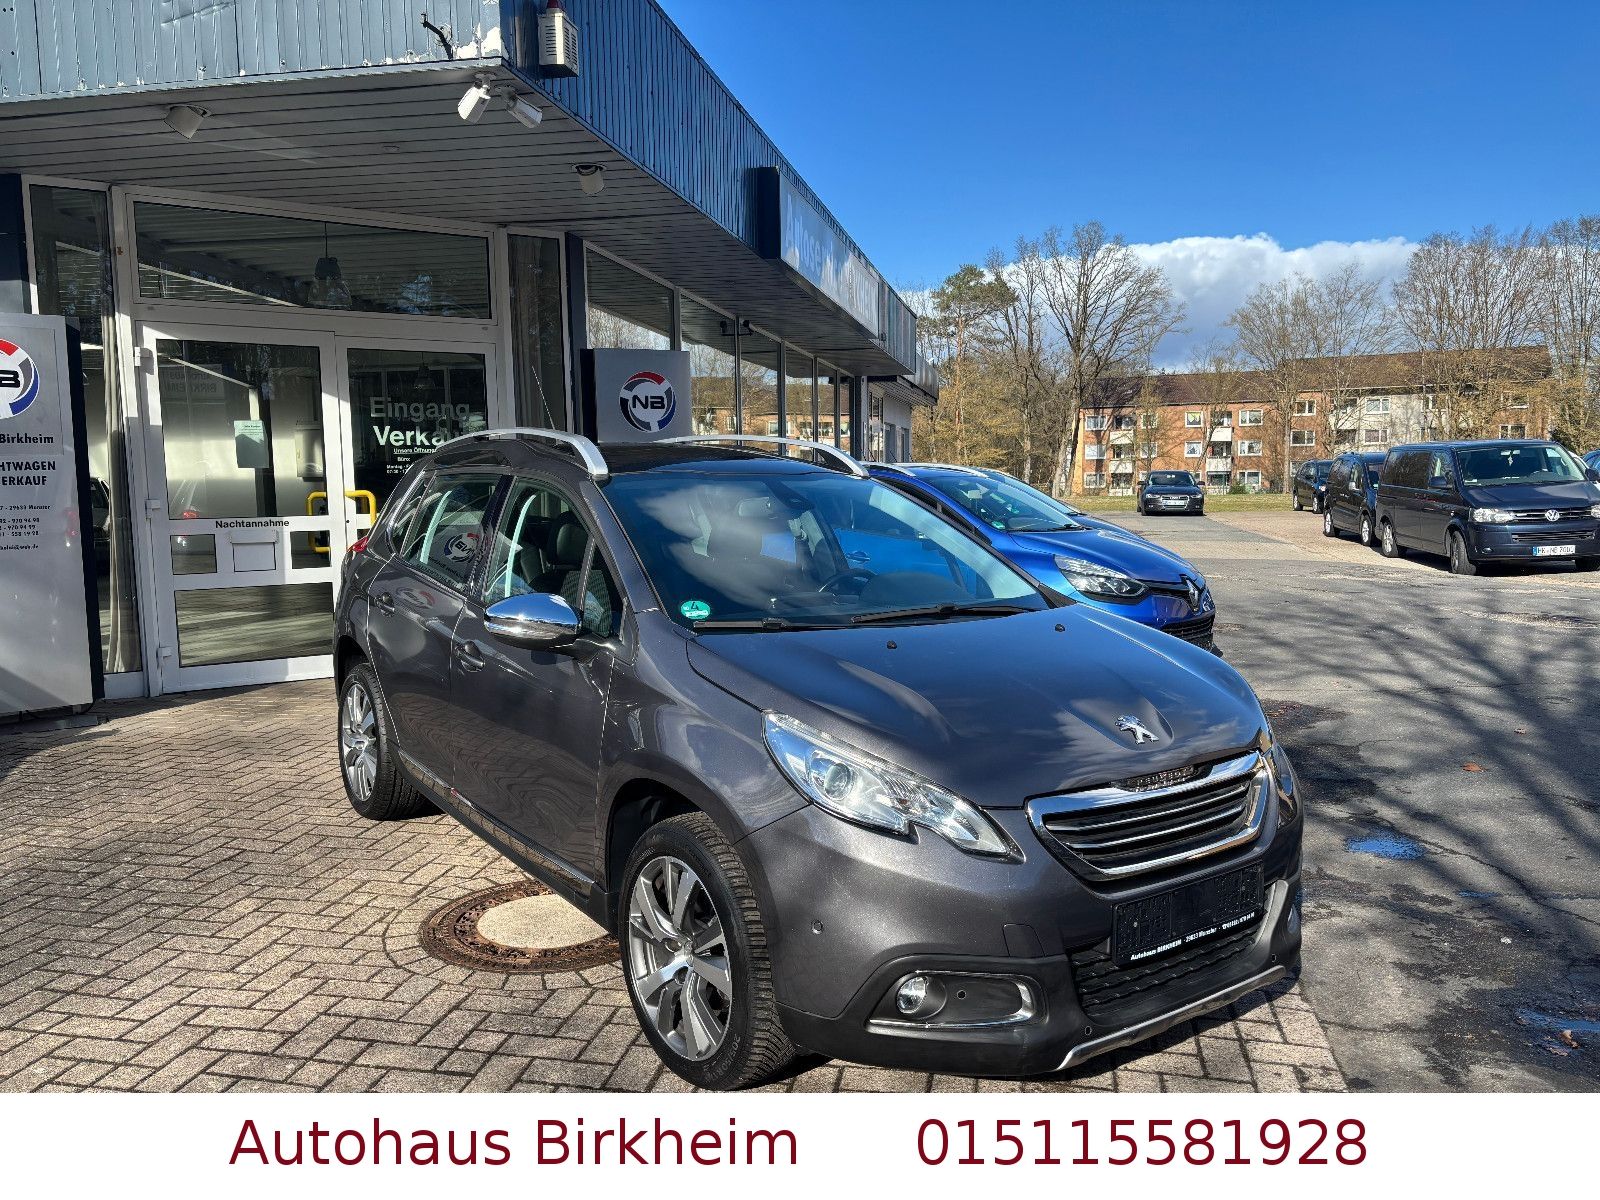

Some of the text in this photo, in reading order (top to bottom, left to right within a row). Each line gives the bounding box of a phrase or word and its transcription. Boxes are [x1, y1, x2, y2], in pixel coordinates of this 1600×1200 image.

[631, 394, 666, 410] NB
[369, 396, 470, 423] Eingang
[0, 432, 54, 444] Birkheim
[215, 519, 290, 529] Nachtannahme
